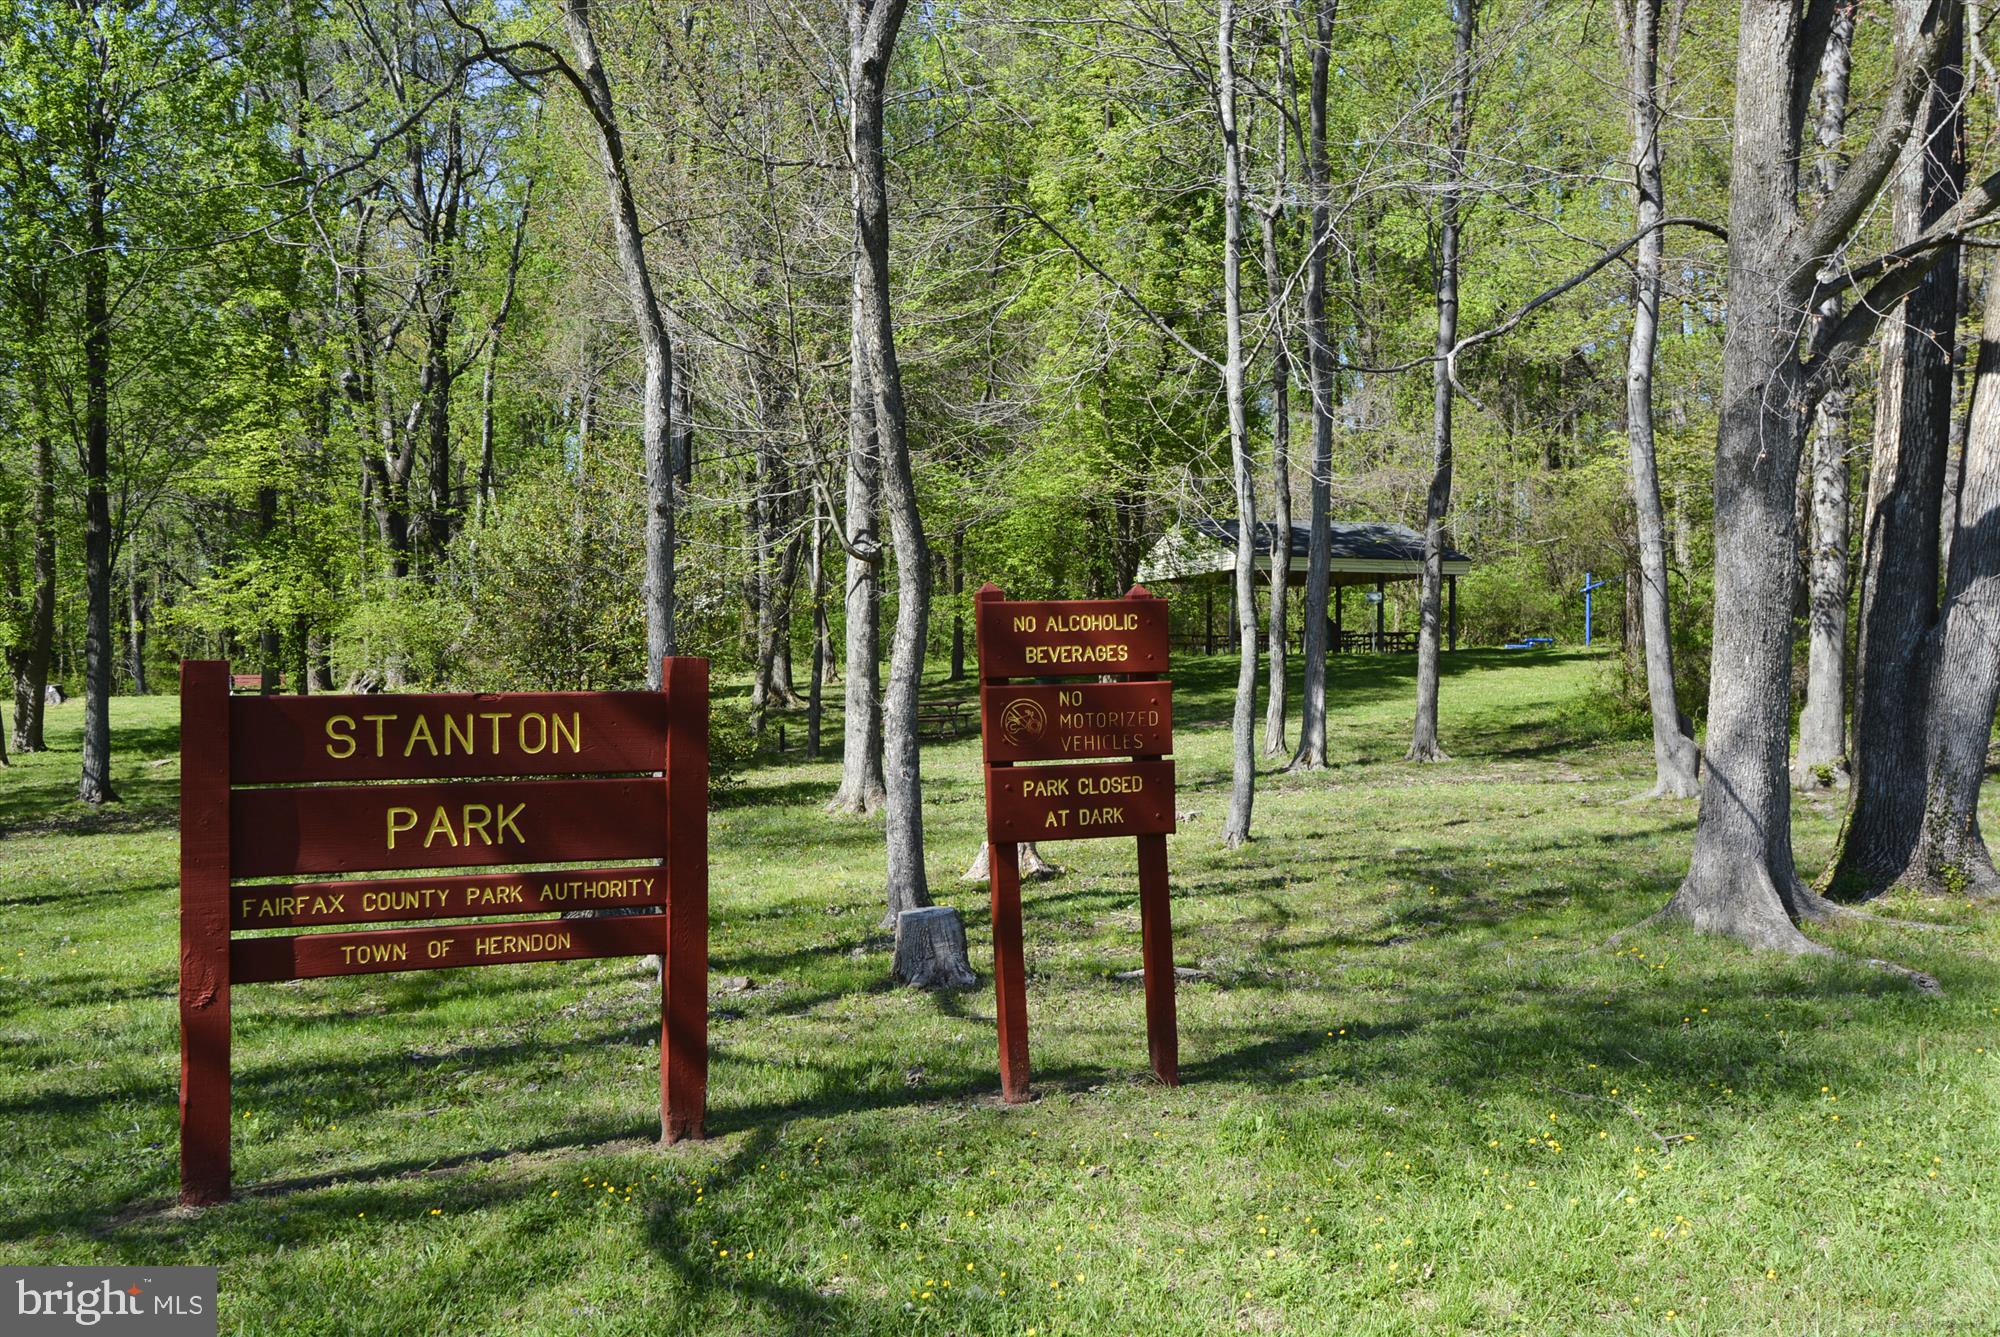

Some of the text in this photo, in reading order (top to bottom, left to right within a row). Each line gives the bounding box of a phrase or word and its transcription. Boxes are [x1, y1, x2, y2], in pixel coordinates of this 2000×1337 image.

[1014, 613, 1139, 633] NO ALCOHOLIC
[1025, 643, 1129, 664] BEVERAGES
[1059, 690, 1083, 707] NO
[1059, 710, 1160, 728] MOTORIZED
[325, 711, 581, 759] STANTON
[1060, 733, 1144, 753] VEHICLES
[1023, 775, 1143, 798] PARK CLOSED
[386, 802, 526, 850] PARK
[1045, 807, 1124, 828] AT DARK
[242, 877, 655, 918] FAIRFAX COUNTY PARK AUTHORITY
[340, 932, 571, 965] TOWN OF HERNDON
